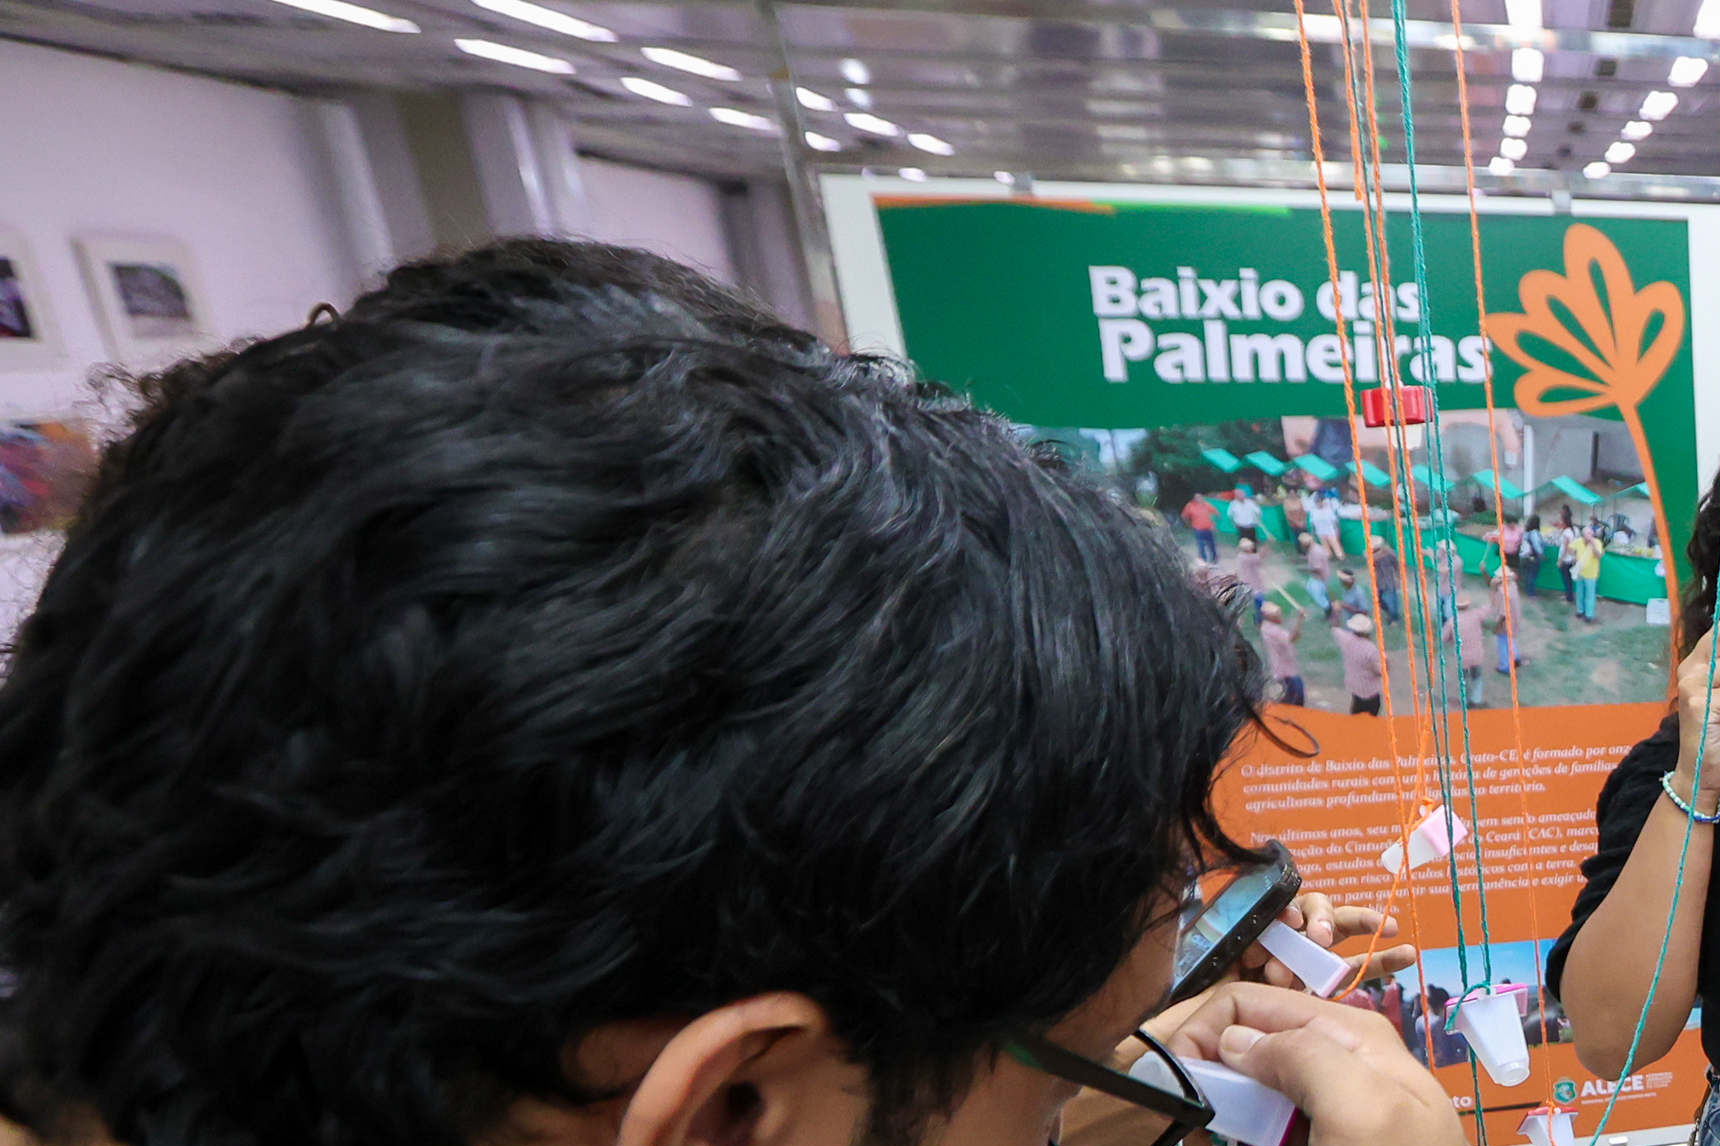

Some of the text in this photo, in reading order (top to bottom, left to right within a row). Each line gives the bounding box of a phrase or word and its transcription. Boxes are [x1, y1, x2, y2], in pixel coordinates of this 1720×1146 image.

[1088, 265, 1422, 323] Baixio das
[1099, 318, 1494, 383] Palmeiras
[1240, 764, 1254, 778] O
[1256, 762, 1304, 777] distrito
[1306, 760, 1323, 774] de
[1325, 758, 1365, 773] Baixio
[1367, 756, 1391, 770] das
[1532, 745, 1583, 762] formado
[1585, 746, 1606, 759] por
[1608, 744, 1631, 756] onz
[1243, 776, 1329, 794] comunidades
[1331, 774, 1369, 789] rurais
[1483, 765, 1497, 780] de
[1554, 761, 1568, 775] de
[1246, 795, 1324, 813] agricultoras
[1279, 828, 1327, 842] últimos
[1330, 826, 1363, 839] anos,
[1366, 824, 1387, 836] seu
[1326, 841, 1342, 854] do
[1486, 829, 1522, 843] Ceará
[1326, 858, 1373, 872] estudos
[1559, 845, 1567, 854] e
[1338, 877, 1357, 886] em
[1360, 872, 1390, 885] risco
[1535, 861, 1543, 871] a
[1545, 857, 1576, 870] terra.
[1344, 891, 1373, 905] para
[1429, 883, 1449, 895] sua
[1532, 878, 1539, 887] e
[1541, 874, 1574, 889] exigir
